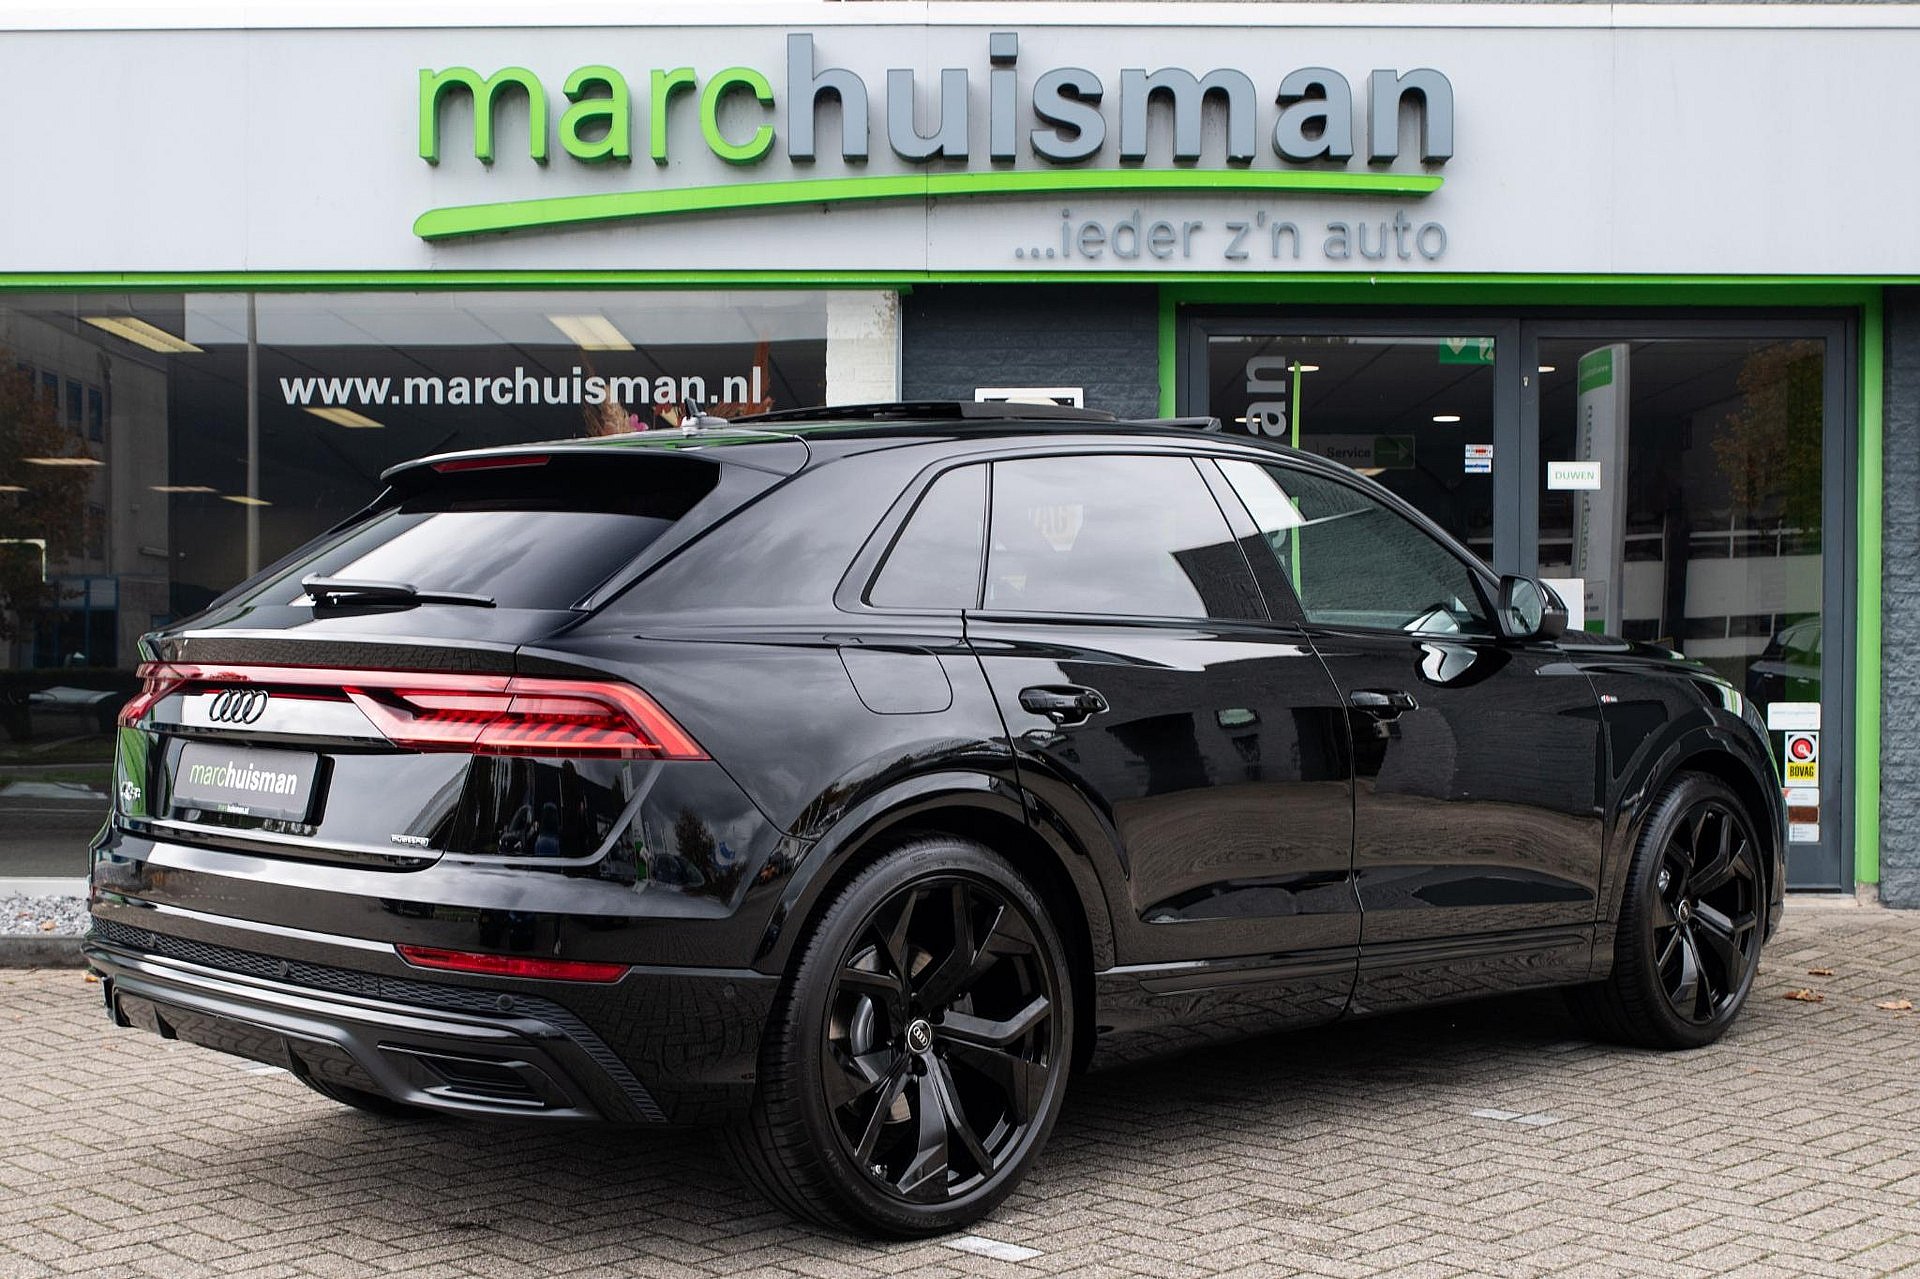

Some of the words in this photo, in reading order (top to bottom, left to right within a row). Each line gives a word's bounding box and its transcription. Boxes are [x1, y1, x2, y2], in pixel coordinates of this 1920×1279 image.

[418, 32, 1454, 165] marchuisman
[1223, 209, 1301, 260] z'n
[1323, 208, 1448, 260] auto
[279, 366, 762, 405] www.marchuisman.nl
[1326, 445, 1372, 460] Service
[1555, 470, 1595, 481] DUWEN
[189, 760, 297, 795] marchuisman
[1789, 765, 1815, 778] BOVAG
